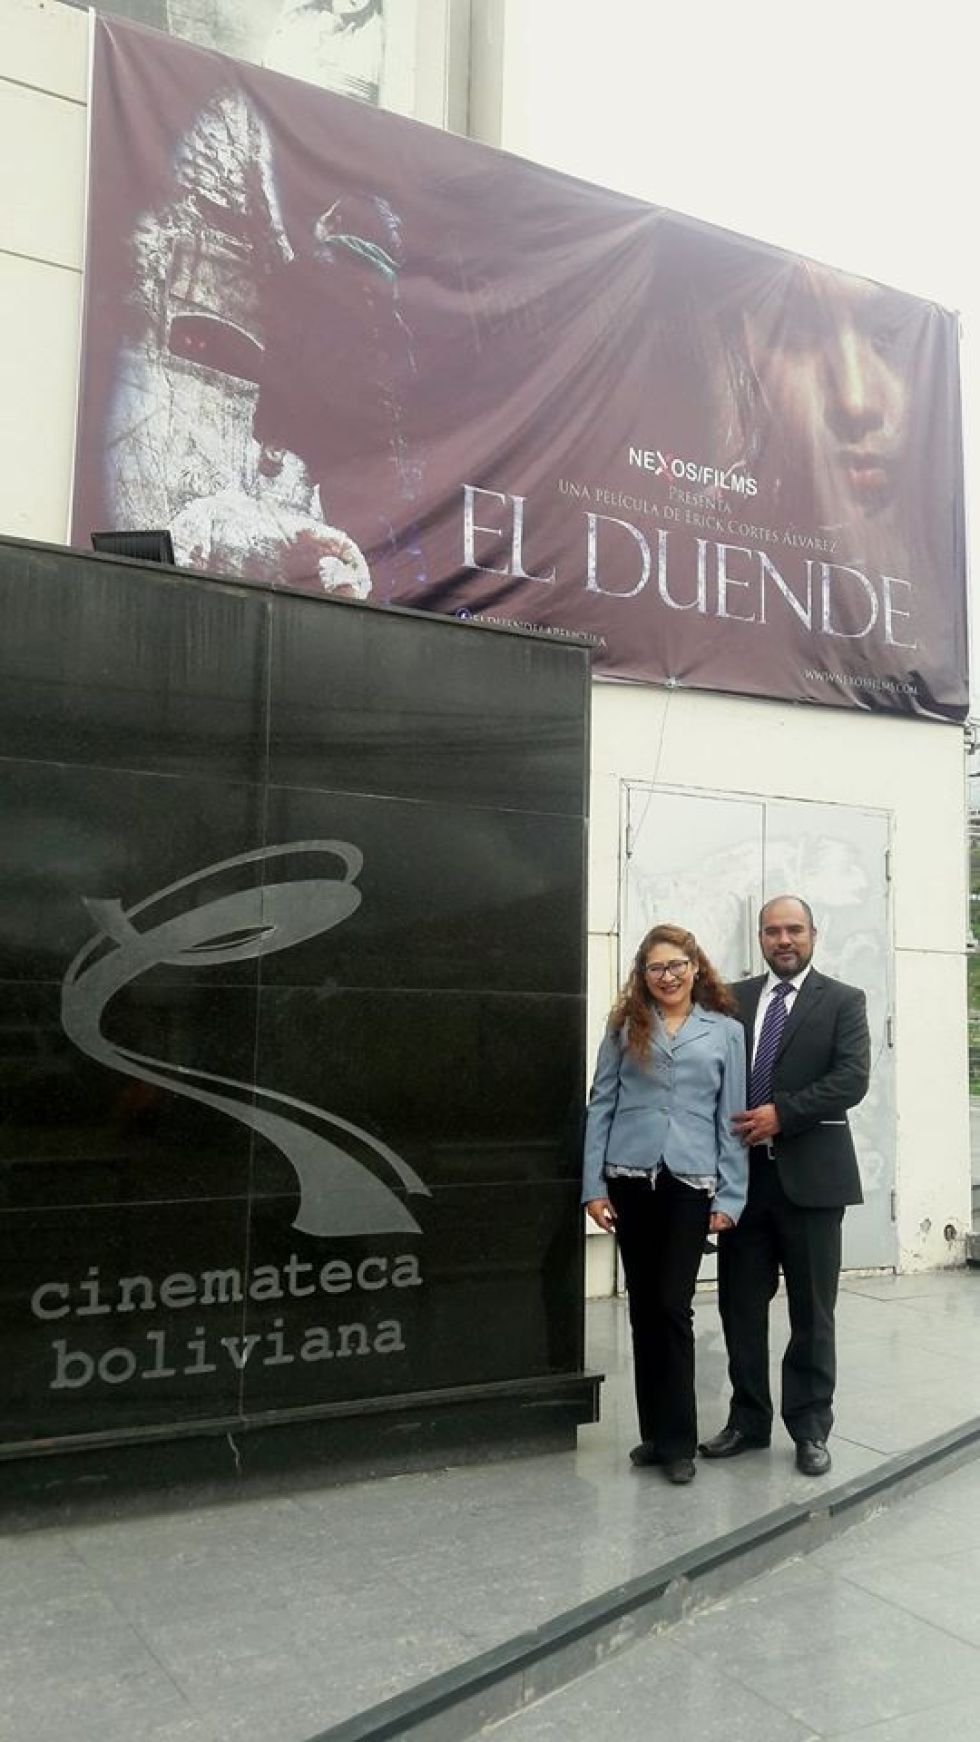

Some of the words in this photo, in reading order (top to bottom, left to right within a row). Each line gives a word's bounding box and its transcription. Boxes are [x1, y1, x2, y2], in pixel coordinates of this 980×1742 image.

[558, 478, 591, 500] UNA
[663, 505, 681, 522] DE
[685, 507, 725, 532] ERICK
[727, 520, 779, 543] CORTES
[669, 486, 732, 514] PRESENTA
[462, 483, 556, 584] EL
[583, 511, 918, 650] DUENDE
[30, 1253, 424, 1320] cinemateca
[49, 1317, 406, 1390] boliviana
